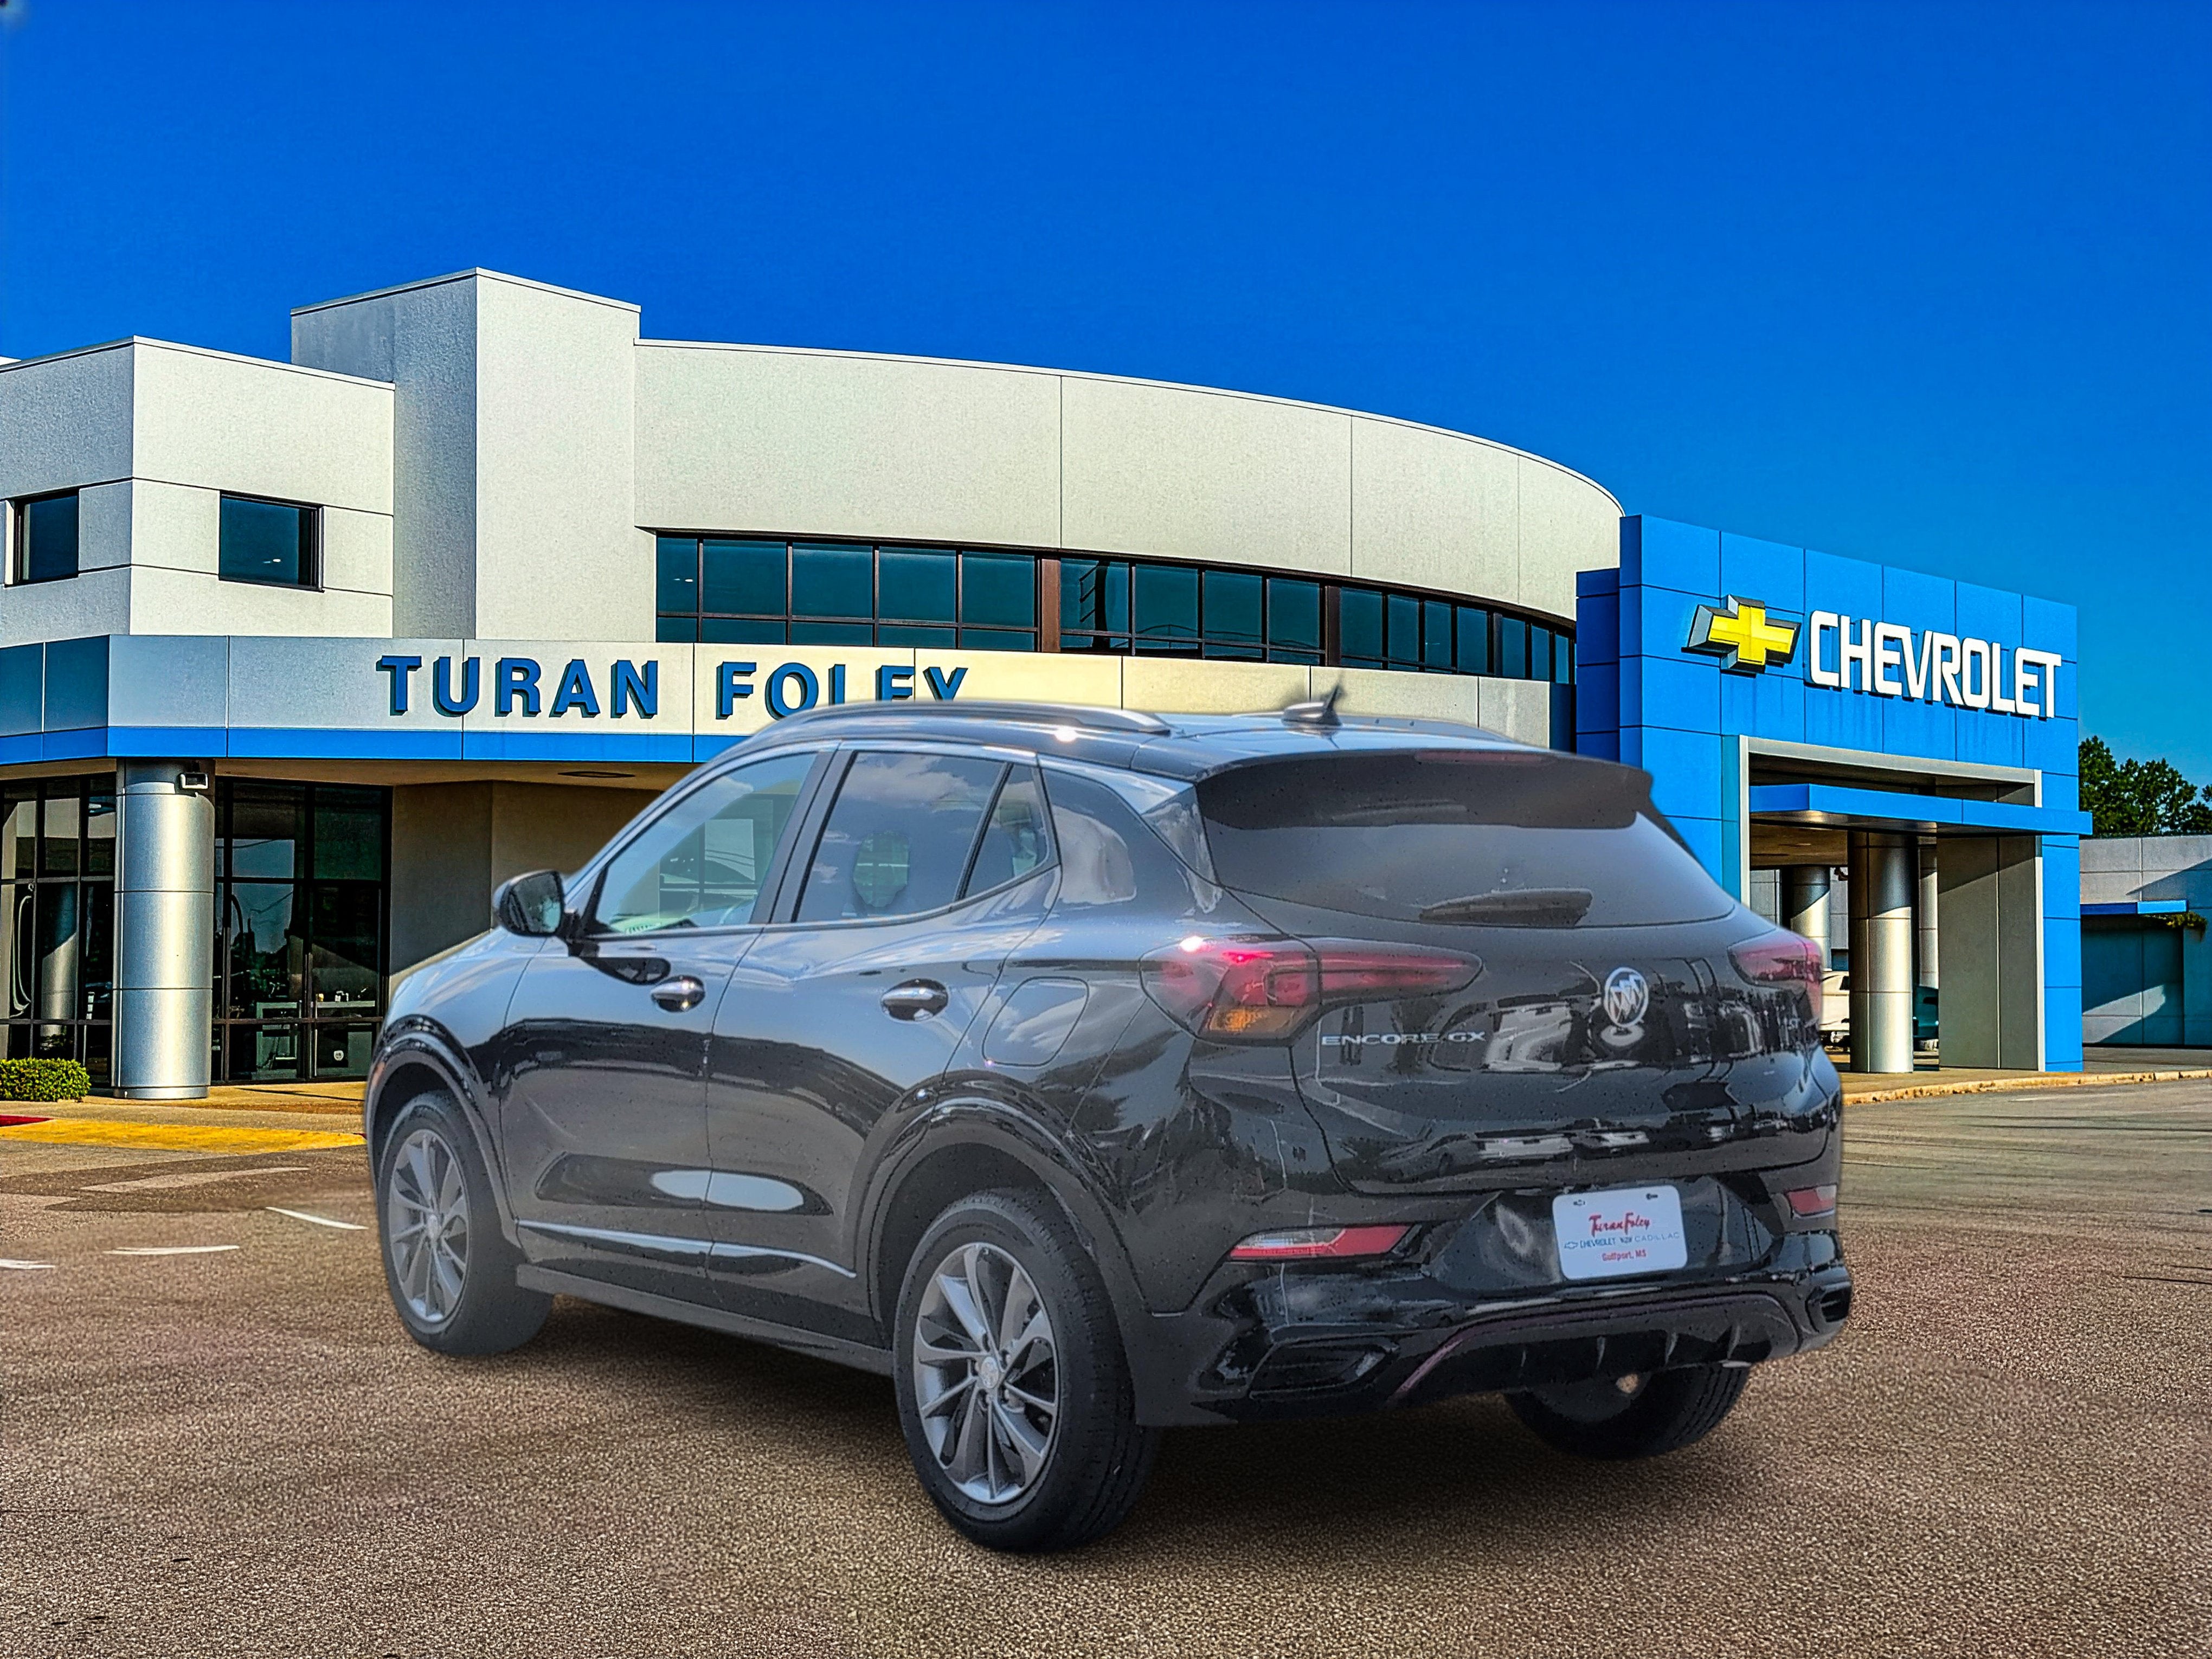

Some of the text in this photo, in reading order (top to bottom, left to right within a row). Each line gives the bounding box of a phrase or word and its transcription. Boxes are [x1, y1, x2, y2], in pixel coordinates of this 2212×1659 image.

[1805, 610, 2062, 719] CHEVROLET
[376, 655, 659, 718] TURAN
[1321, 1031, 1486, 1046] ENCORE GX
[1580, 1231, 1680, 1249] CHEVROLET CADILLAC
